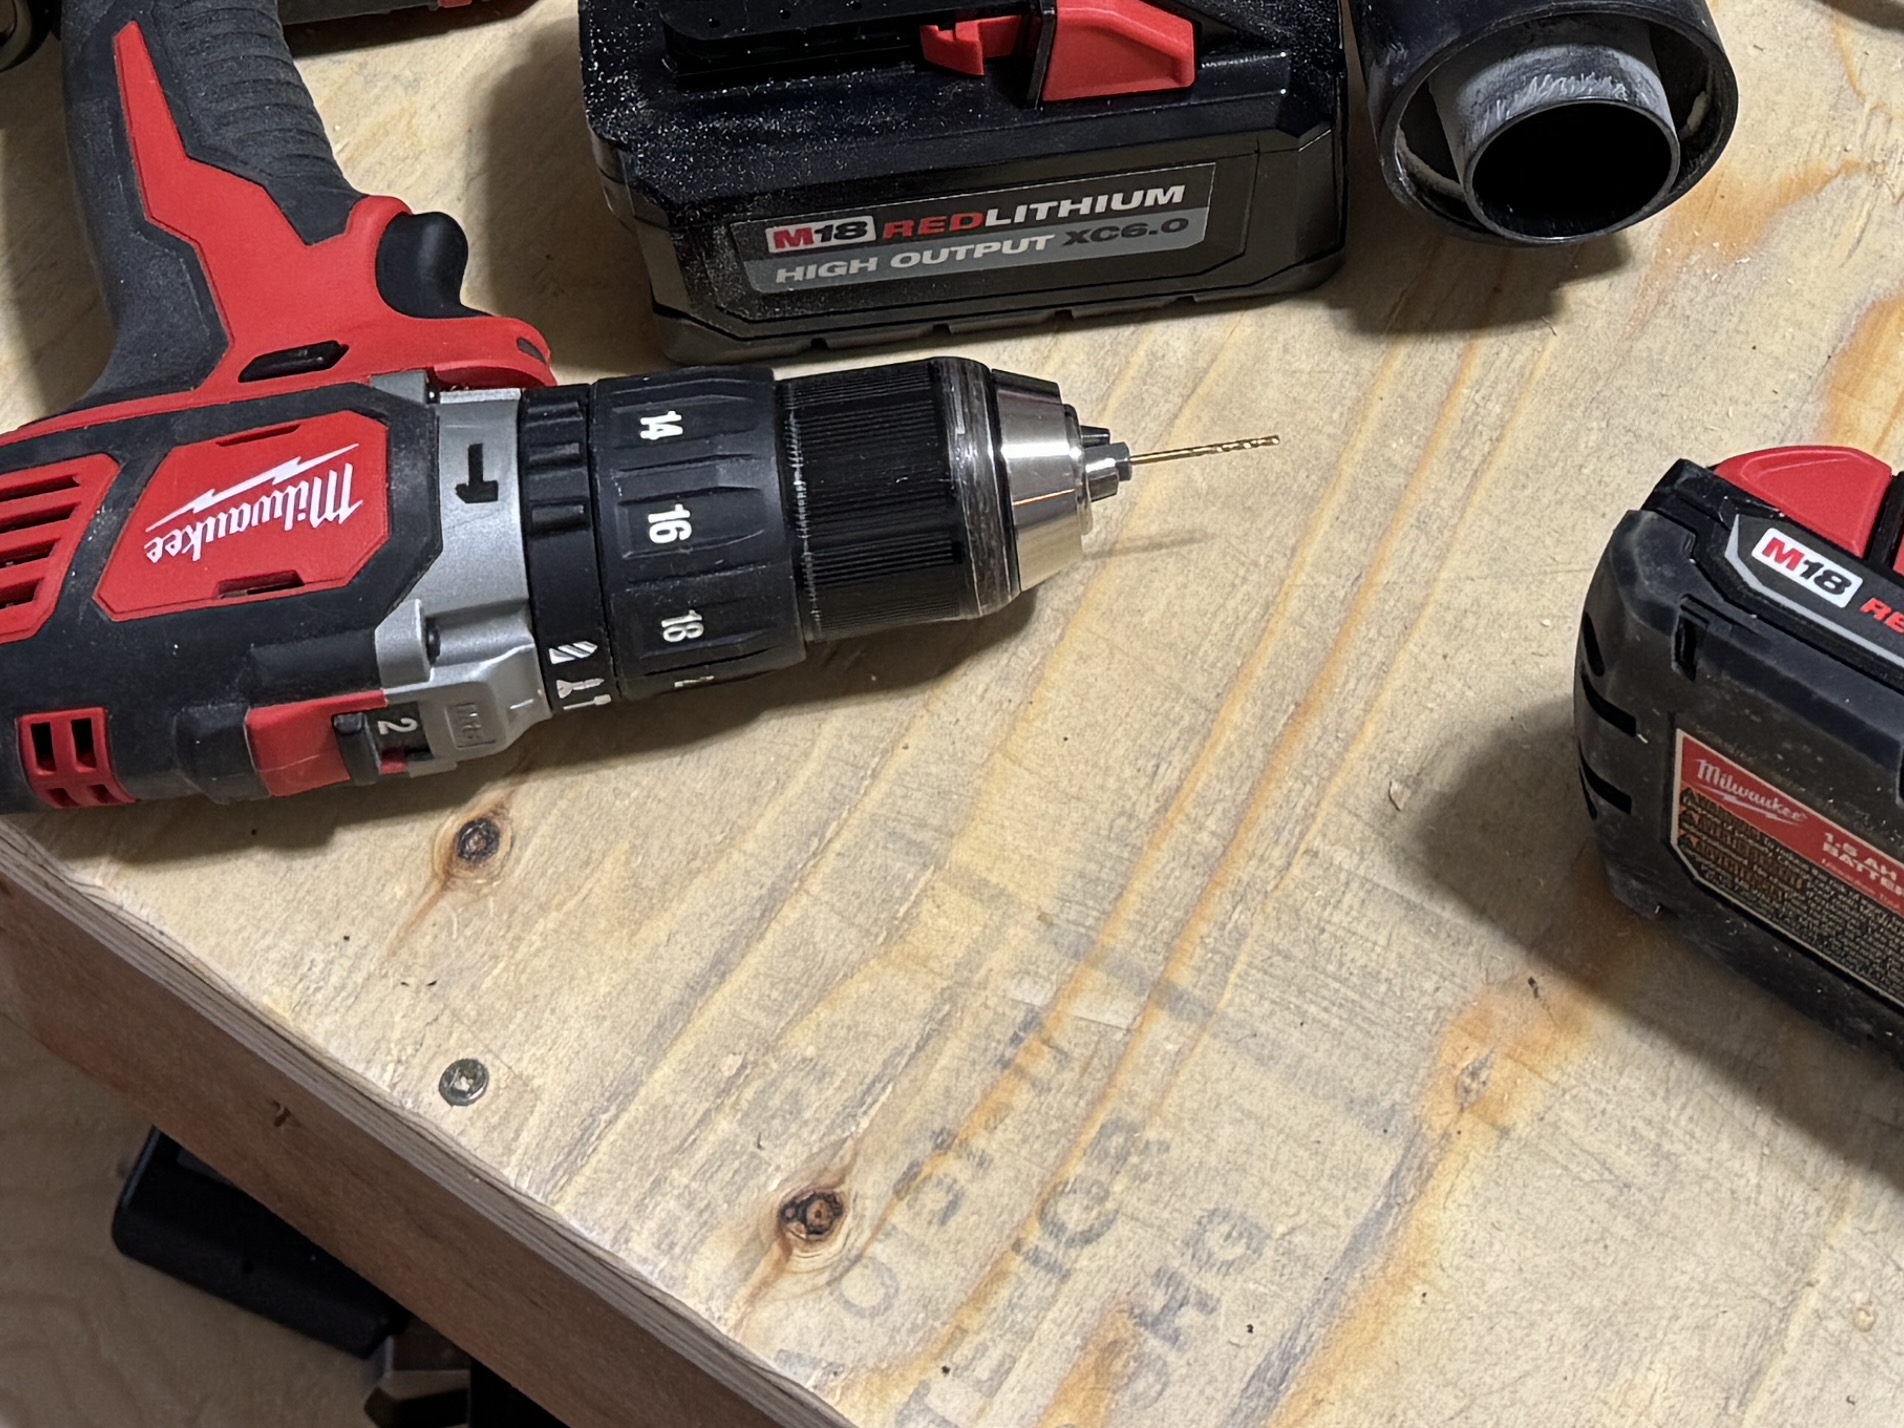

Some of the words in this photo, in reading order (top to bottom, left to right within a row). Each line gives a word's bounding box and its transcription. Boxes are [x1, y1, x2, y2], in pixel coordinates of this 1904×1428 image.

[774, 216, 869, 250] M18
[883, 182, 1187, 241] REDLITHIUM
[776, 256, 879, 284] HIGH
[890, 233, 1057, 272] OUTPUT
[1062, 216, 1190, 248] XC6.0
[637, 408, 684, 445] 14
[142, 460, 364, 565] Milwaukee
[647, 502, 693, 547] 16
[1763, 535, 1851, 597] M18
[661, 609, 704, 643] 18
[378, 715, 417, 738] 2
[1694, 760, 1803, 827] Milwaukee
[1863, 855, 1899, 881] AH
